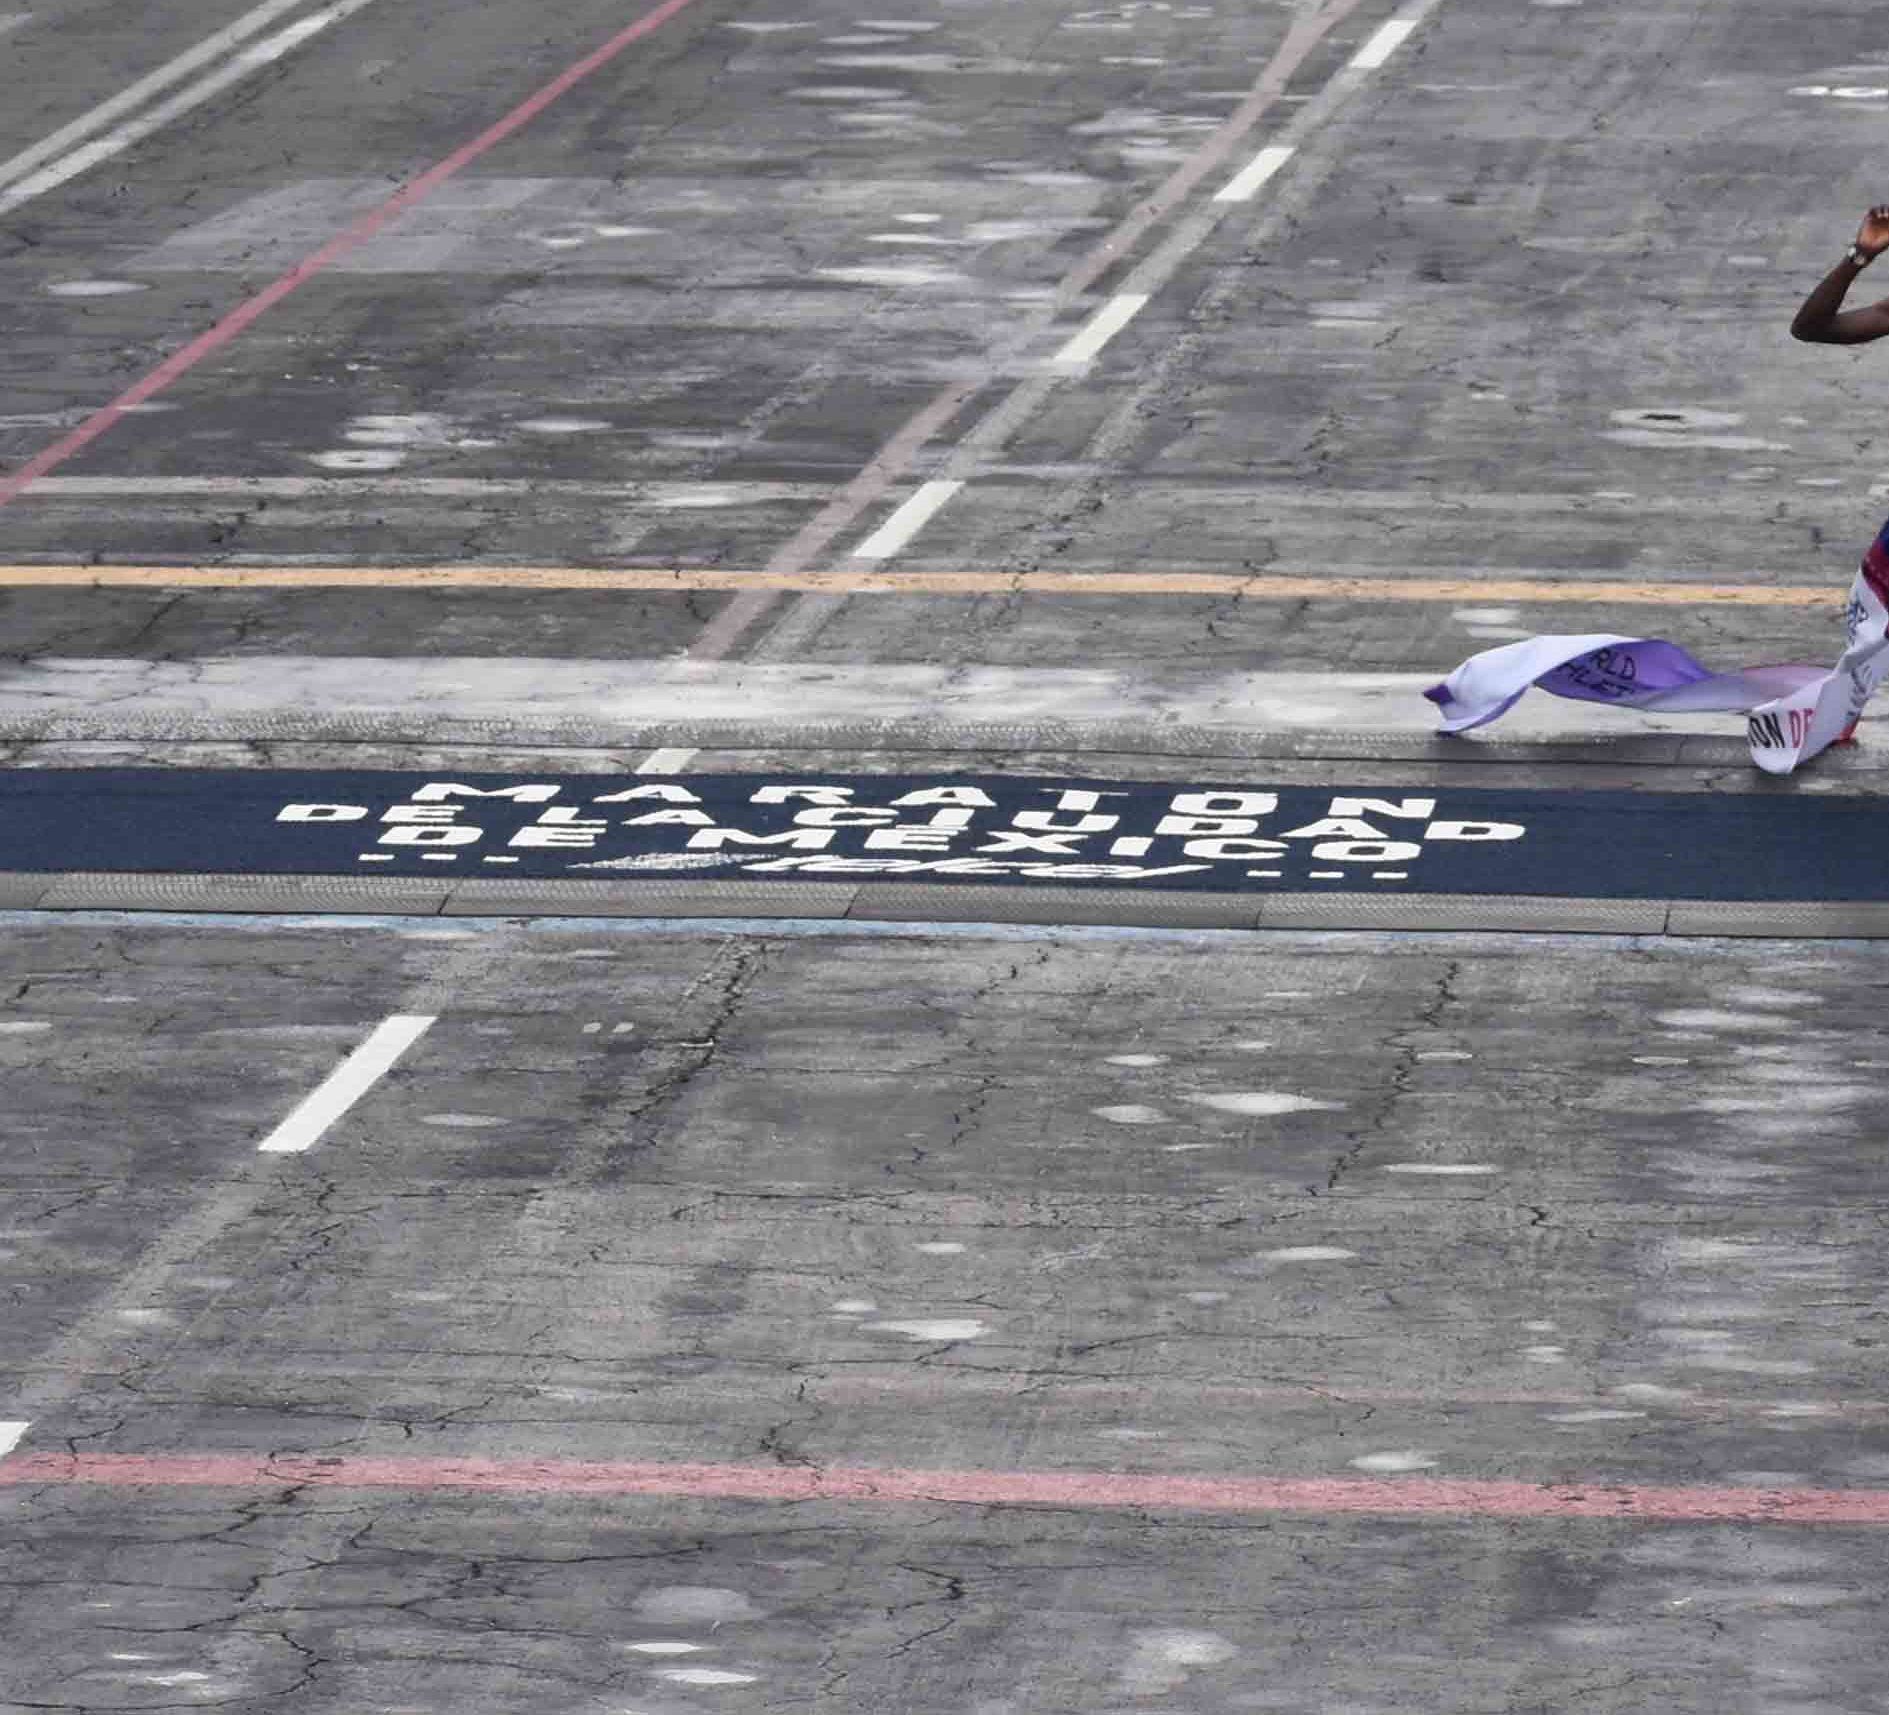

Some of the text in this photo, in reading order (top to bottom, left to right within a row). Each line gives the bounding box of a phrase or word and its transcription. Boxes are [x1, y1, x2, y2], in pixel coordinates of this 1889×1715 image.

[276, 804, 1524, 841] DE LA CIUDAD
[377, 825, 606, 847] DE
